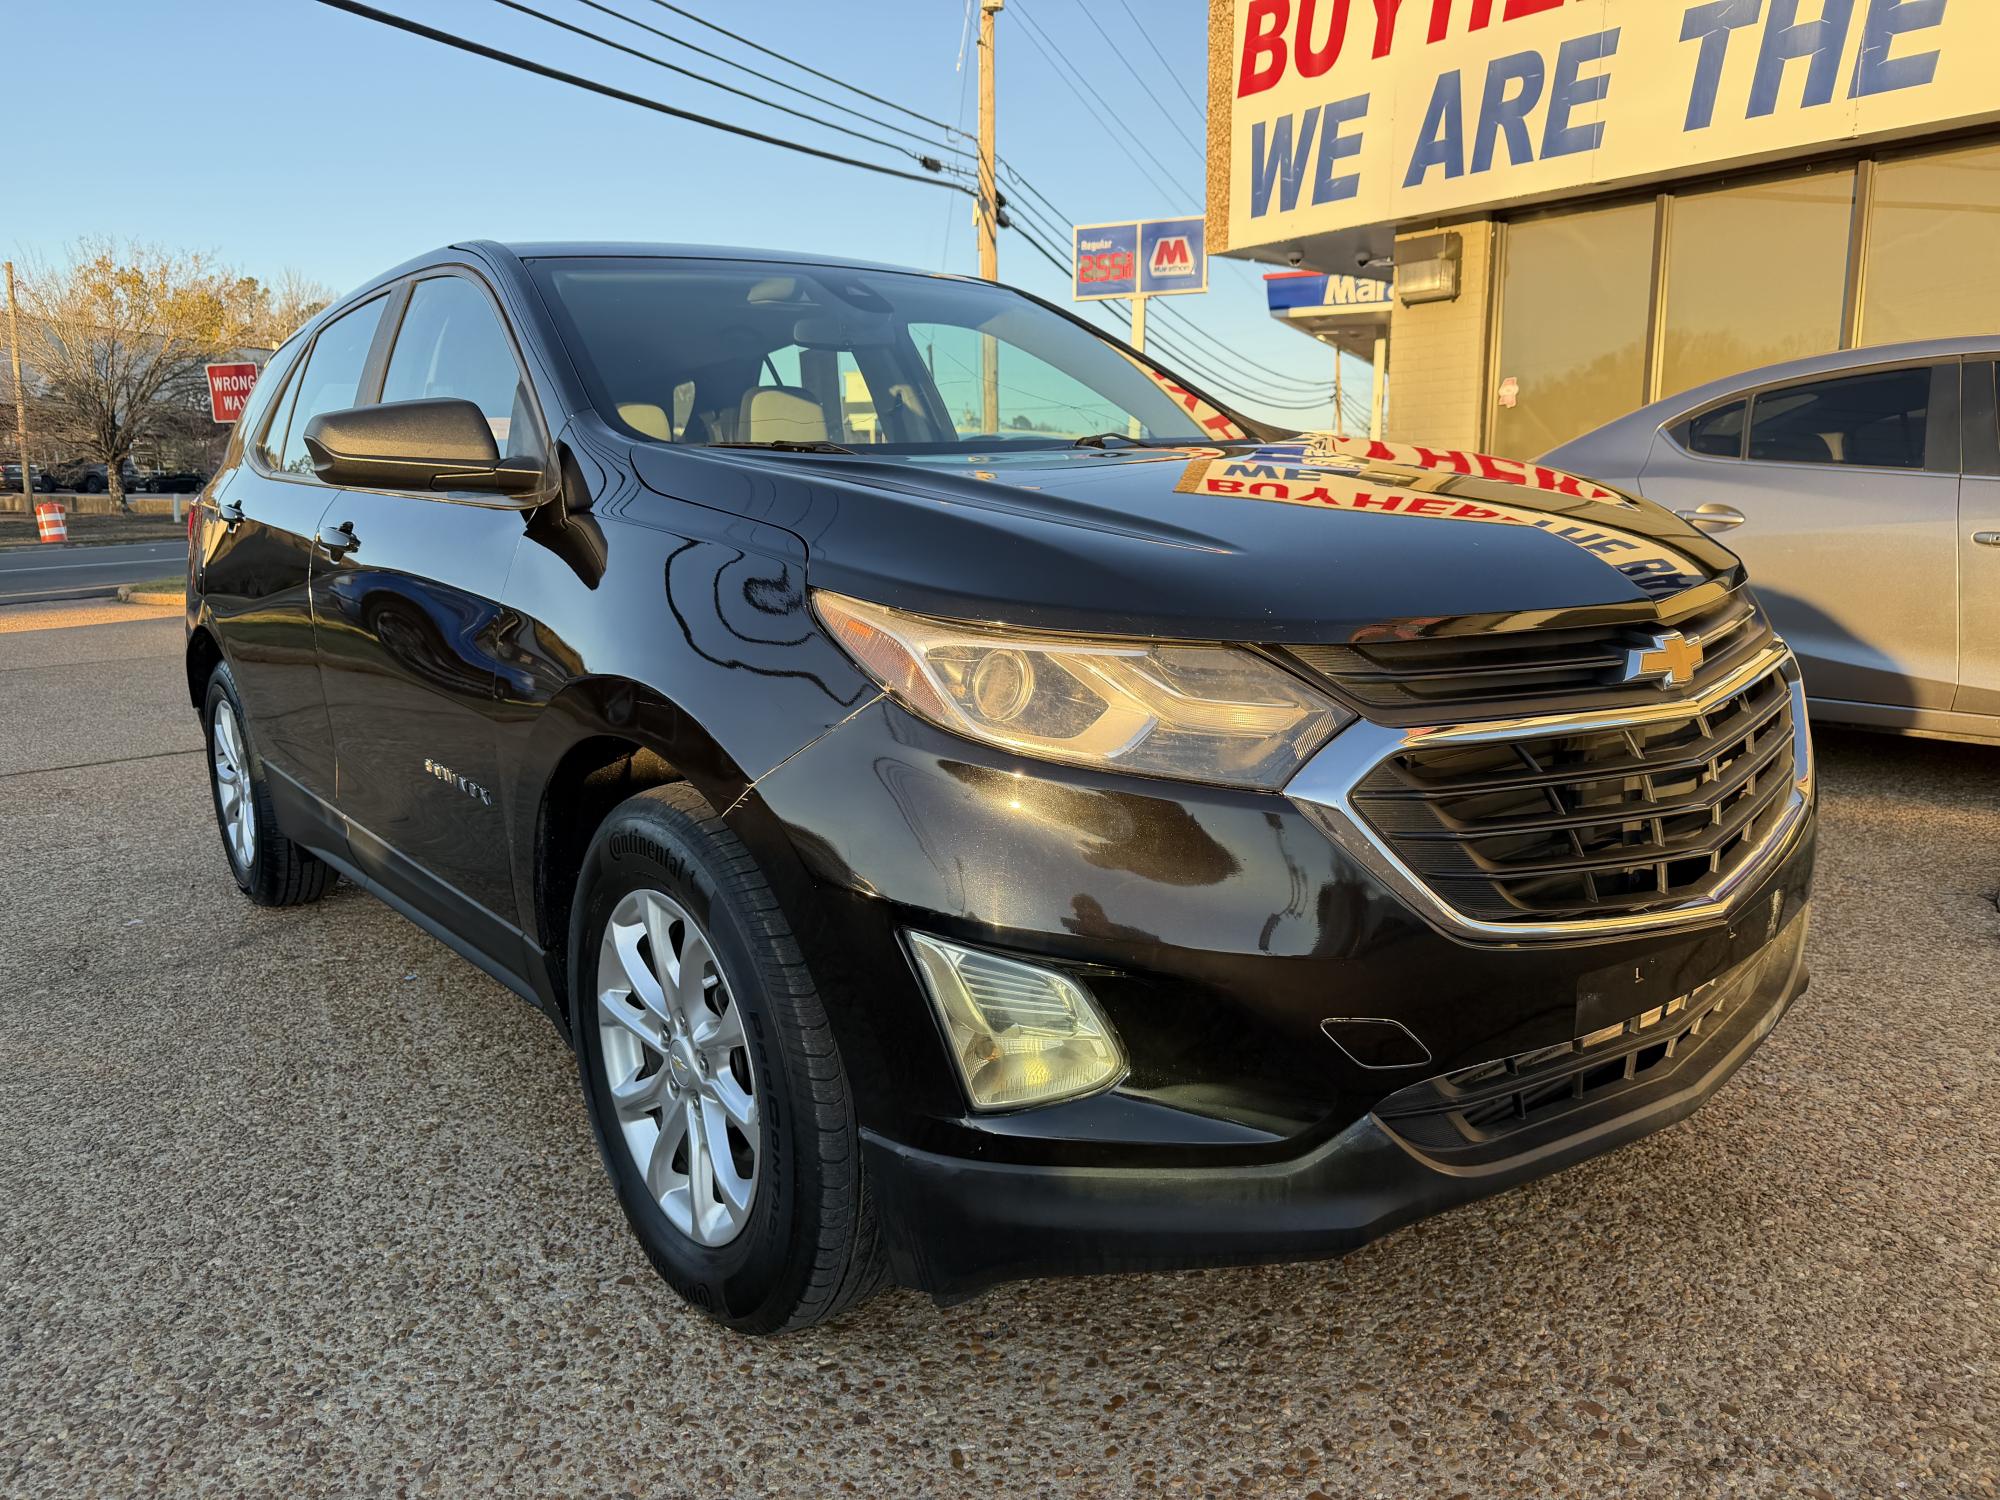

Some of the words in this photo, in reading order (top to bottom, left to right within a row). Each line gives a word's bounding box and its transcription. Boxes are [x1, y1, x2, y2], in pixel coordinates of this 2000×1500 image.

[1251, 93, 1370, 218] WE
[1402, 27, 1621, 188] ARE
[1679, 0, 1948, 132] THE
[1081, 239, 1112, 251] Regular
[212, 375, 257, 392] WRONG
[609, 828, 686, 882] Continental
